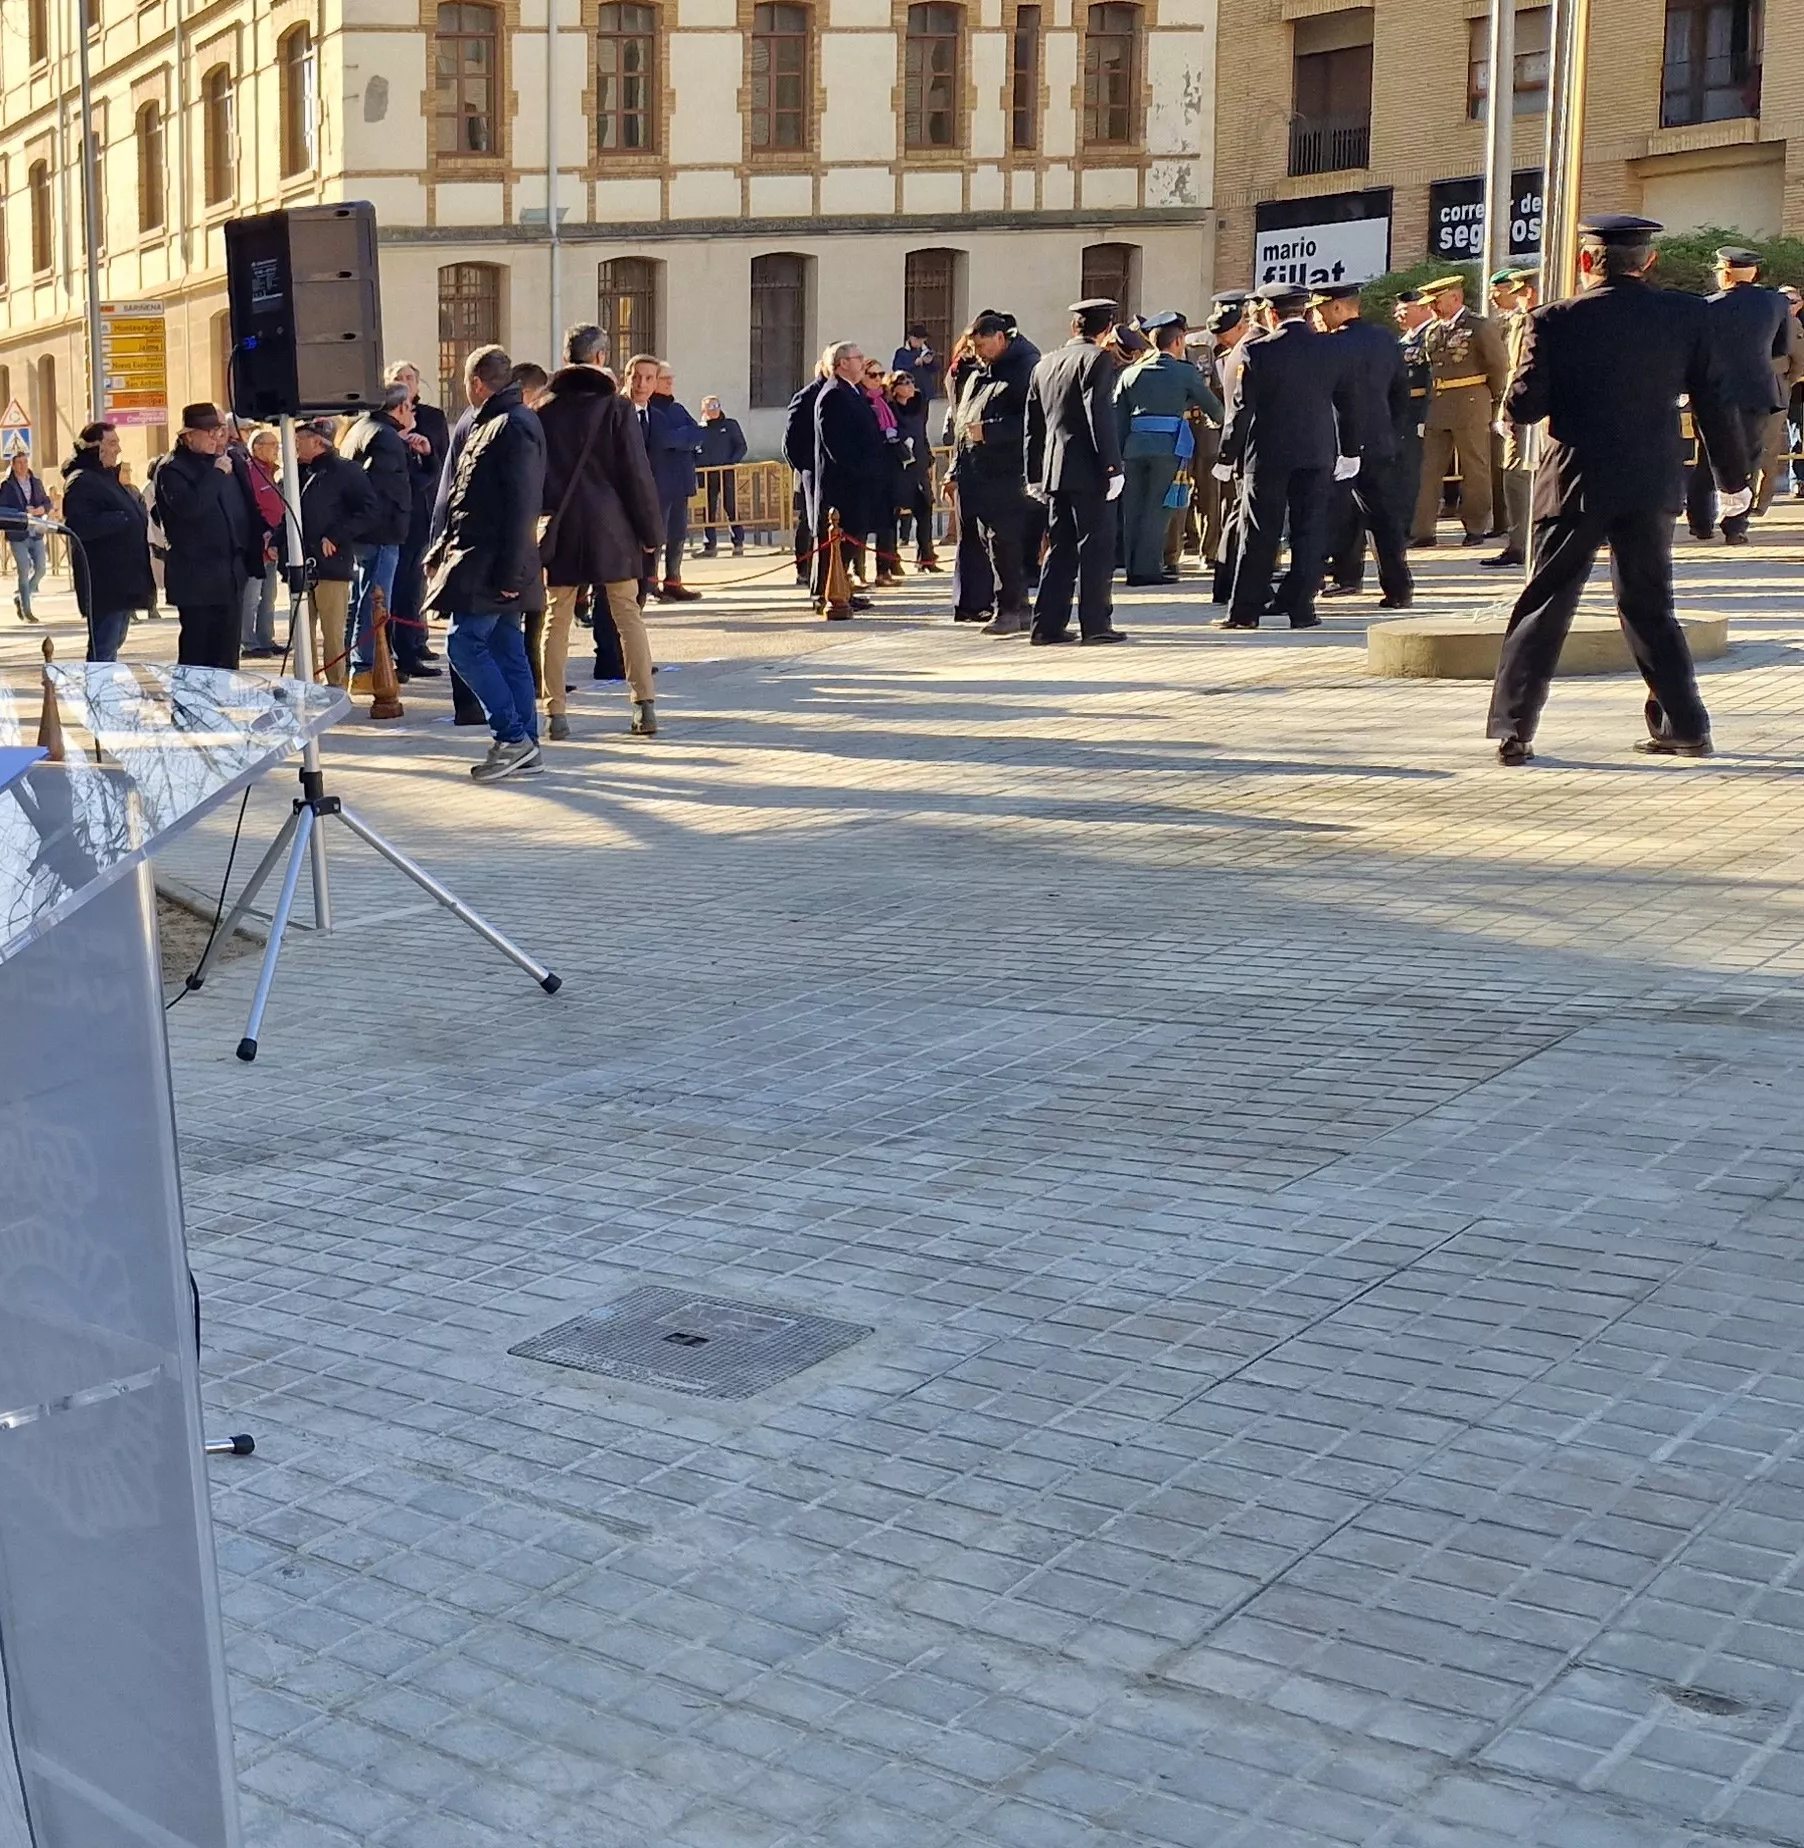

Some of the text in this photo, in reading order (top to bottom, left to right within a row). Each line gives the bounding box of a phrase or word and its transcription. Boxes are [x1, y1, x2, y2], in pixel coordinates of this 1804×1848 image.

[1521, 193, 1542, 213] de
[1439, 217, 1541, 253] segos
[1263, 236, 1317, 262] mario
[1262, 260, 1345, 285] fillat
